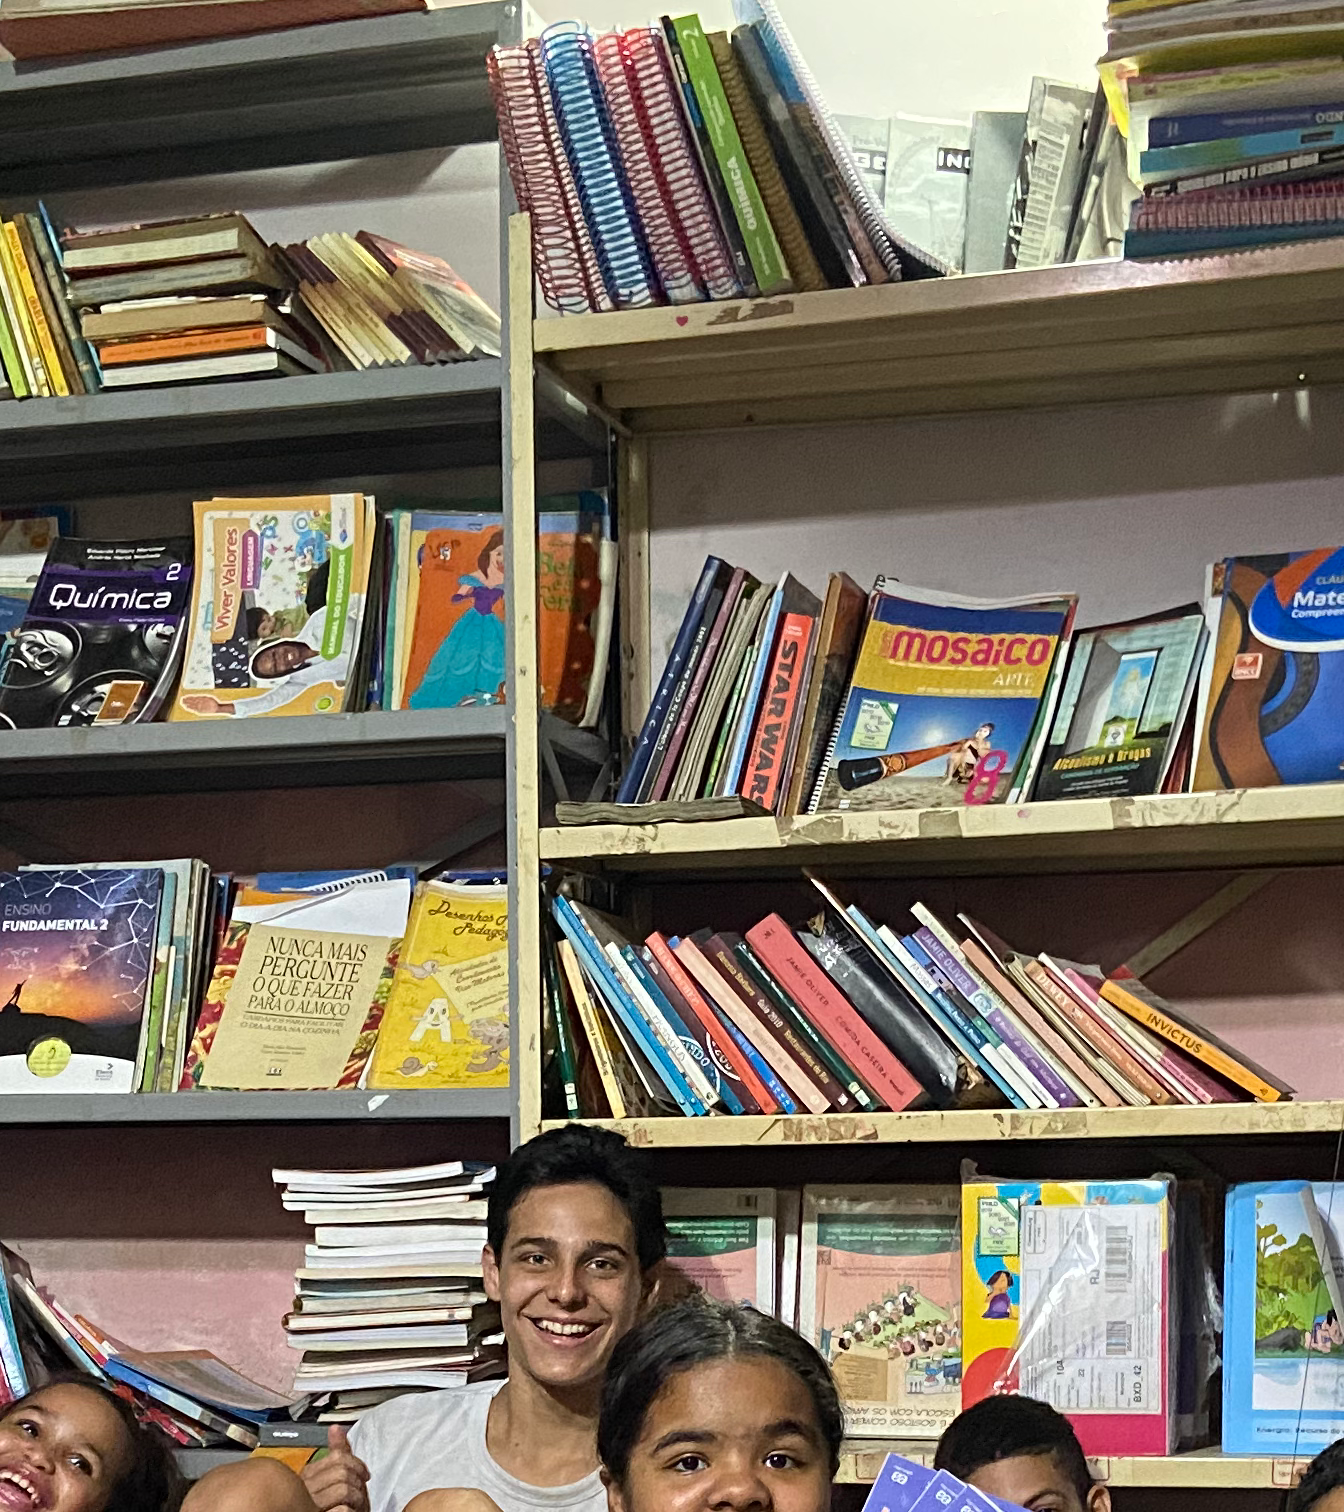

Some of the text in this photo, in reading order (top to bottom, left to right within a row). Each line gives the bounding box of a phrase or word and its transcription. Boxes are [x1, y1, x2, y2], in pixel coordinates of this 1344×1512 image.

[166, 563, 182, 581] 2
[215, 526, 239, 632] Viver Valores
[49, 583, 172, 610] Química
[890, 629, 1051, 667] mosaico
[767, 639, 799, 720] STAR
[965, 750, 1007, 806] 8
[4, 903, 52, 917] ENSINO
[427, 900, 494, 923] Desenhos
[2, 918, 108, 932] FUNDAMENTAL 2
[265, 937, 369, 962] NUNCA MAIS
[258, 955, 364, 984] PERGUNTE
[252, 979, 354, 1001] O QUE FAZER
[804, 978, 830, 1007] OLIVER
[1035, 972, 1070, 1008] DEWEY
[248, 995, 351, 1017] PARA O ALMOÇO
[409, 998, 452, 1043] A
[1146, 1012, 1203, 1054] INVICTUS
[872, 1407, 886, 1415] OS
[890, 1418, 936, 1426] GOSTOSO
[916, 1408, 954, 1416] ESCOLA
